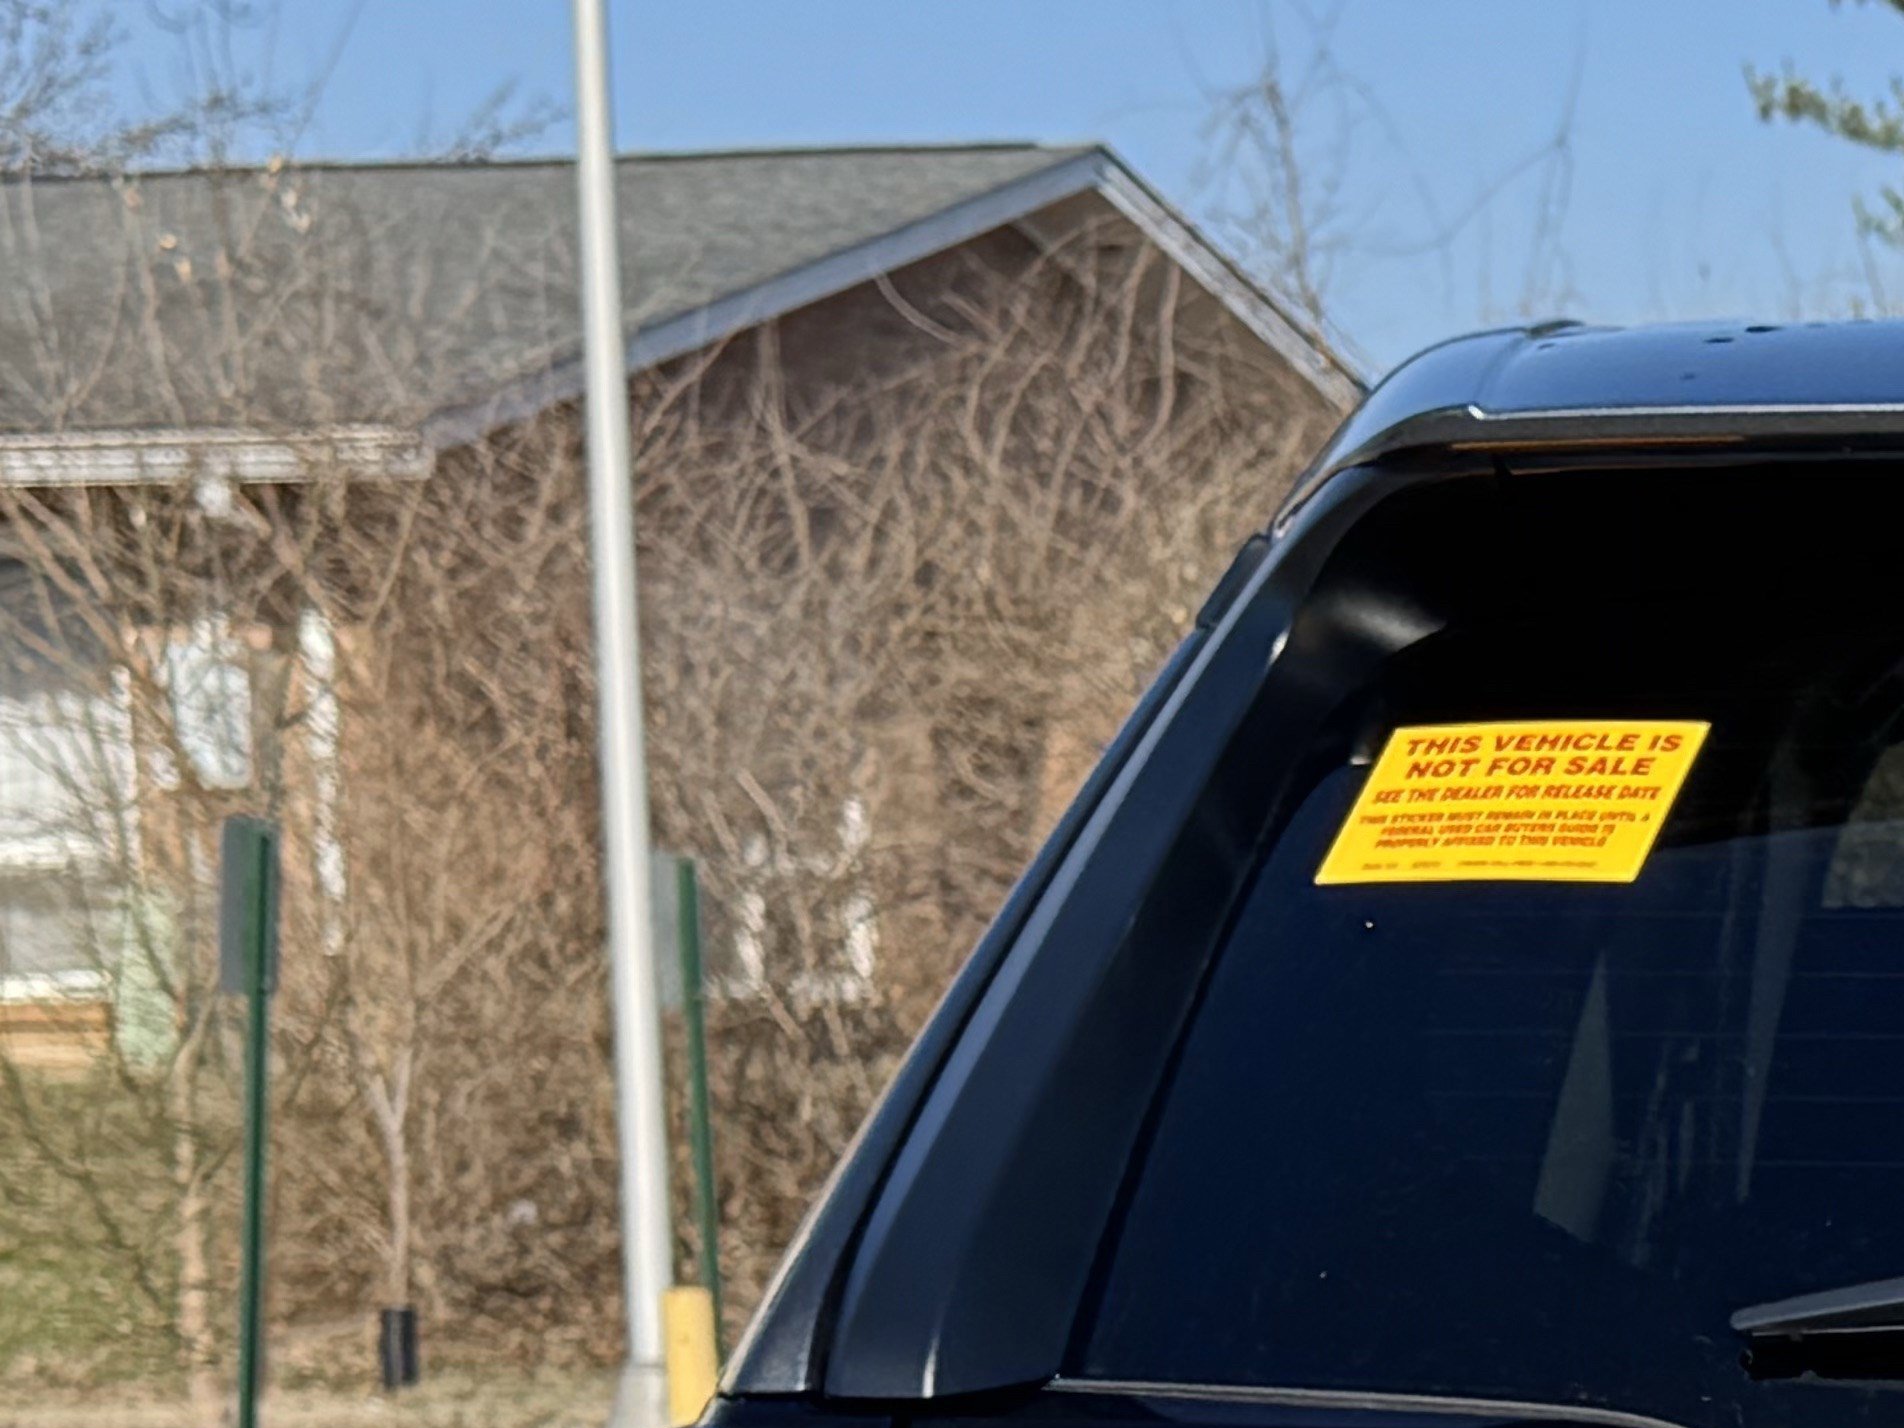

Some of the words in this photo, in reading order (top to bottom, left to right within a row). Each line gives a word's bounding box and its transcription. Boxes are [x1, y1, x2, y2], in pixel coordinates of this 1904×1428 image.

[1407, 736, 1482, 756] THIS
[1495, 734, 1640, 752] VEHICLE
[1648, 735, 1683, 752] IS
[1405, 758, 1481, 779] NOT
[1485, 757, 1556, 777] FOR
[1563, 756, 1657, 775] SALE
[1372, 789, 1405, 804] SEE
[1407, 787, 1440, 803] THE
[1440, 786, 1504, 801] DEALER
[1505, 785, 1541, 800] FOR
[1540, 785, 1618, 800] RELEASE
[1617, 785, 1661, 800] DATE
